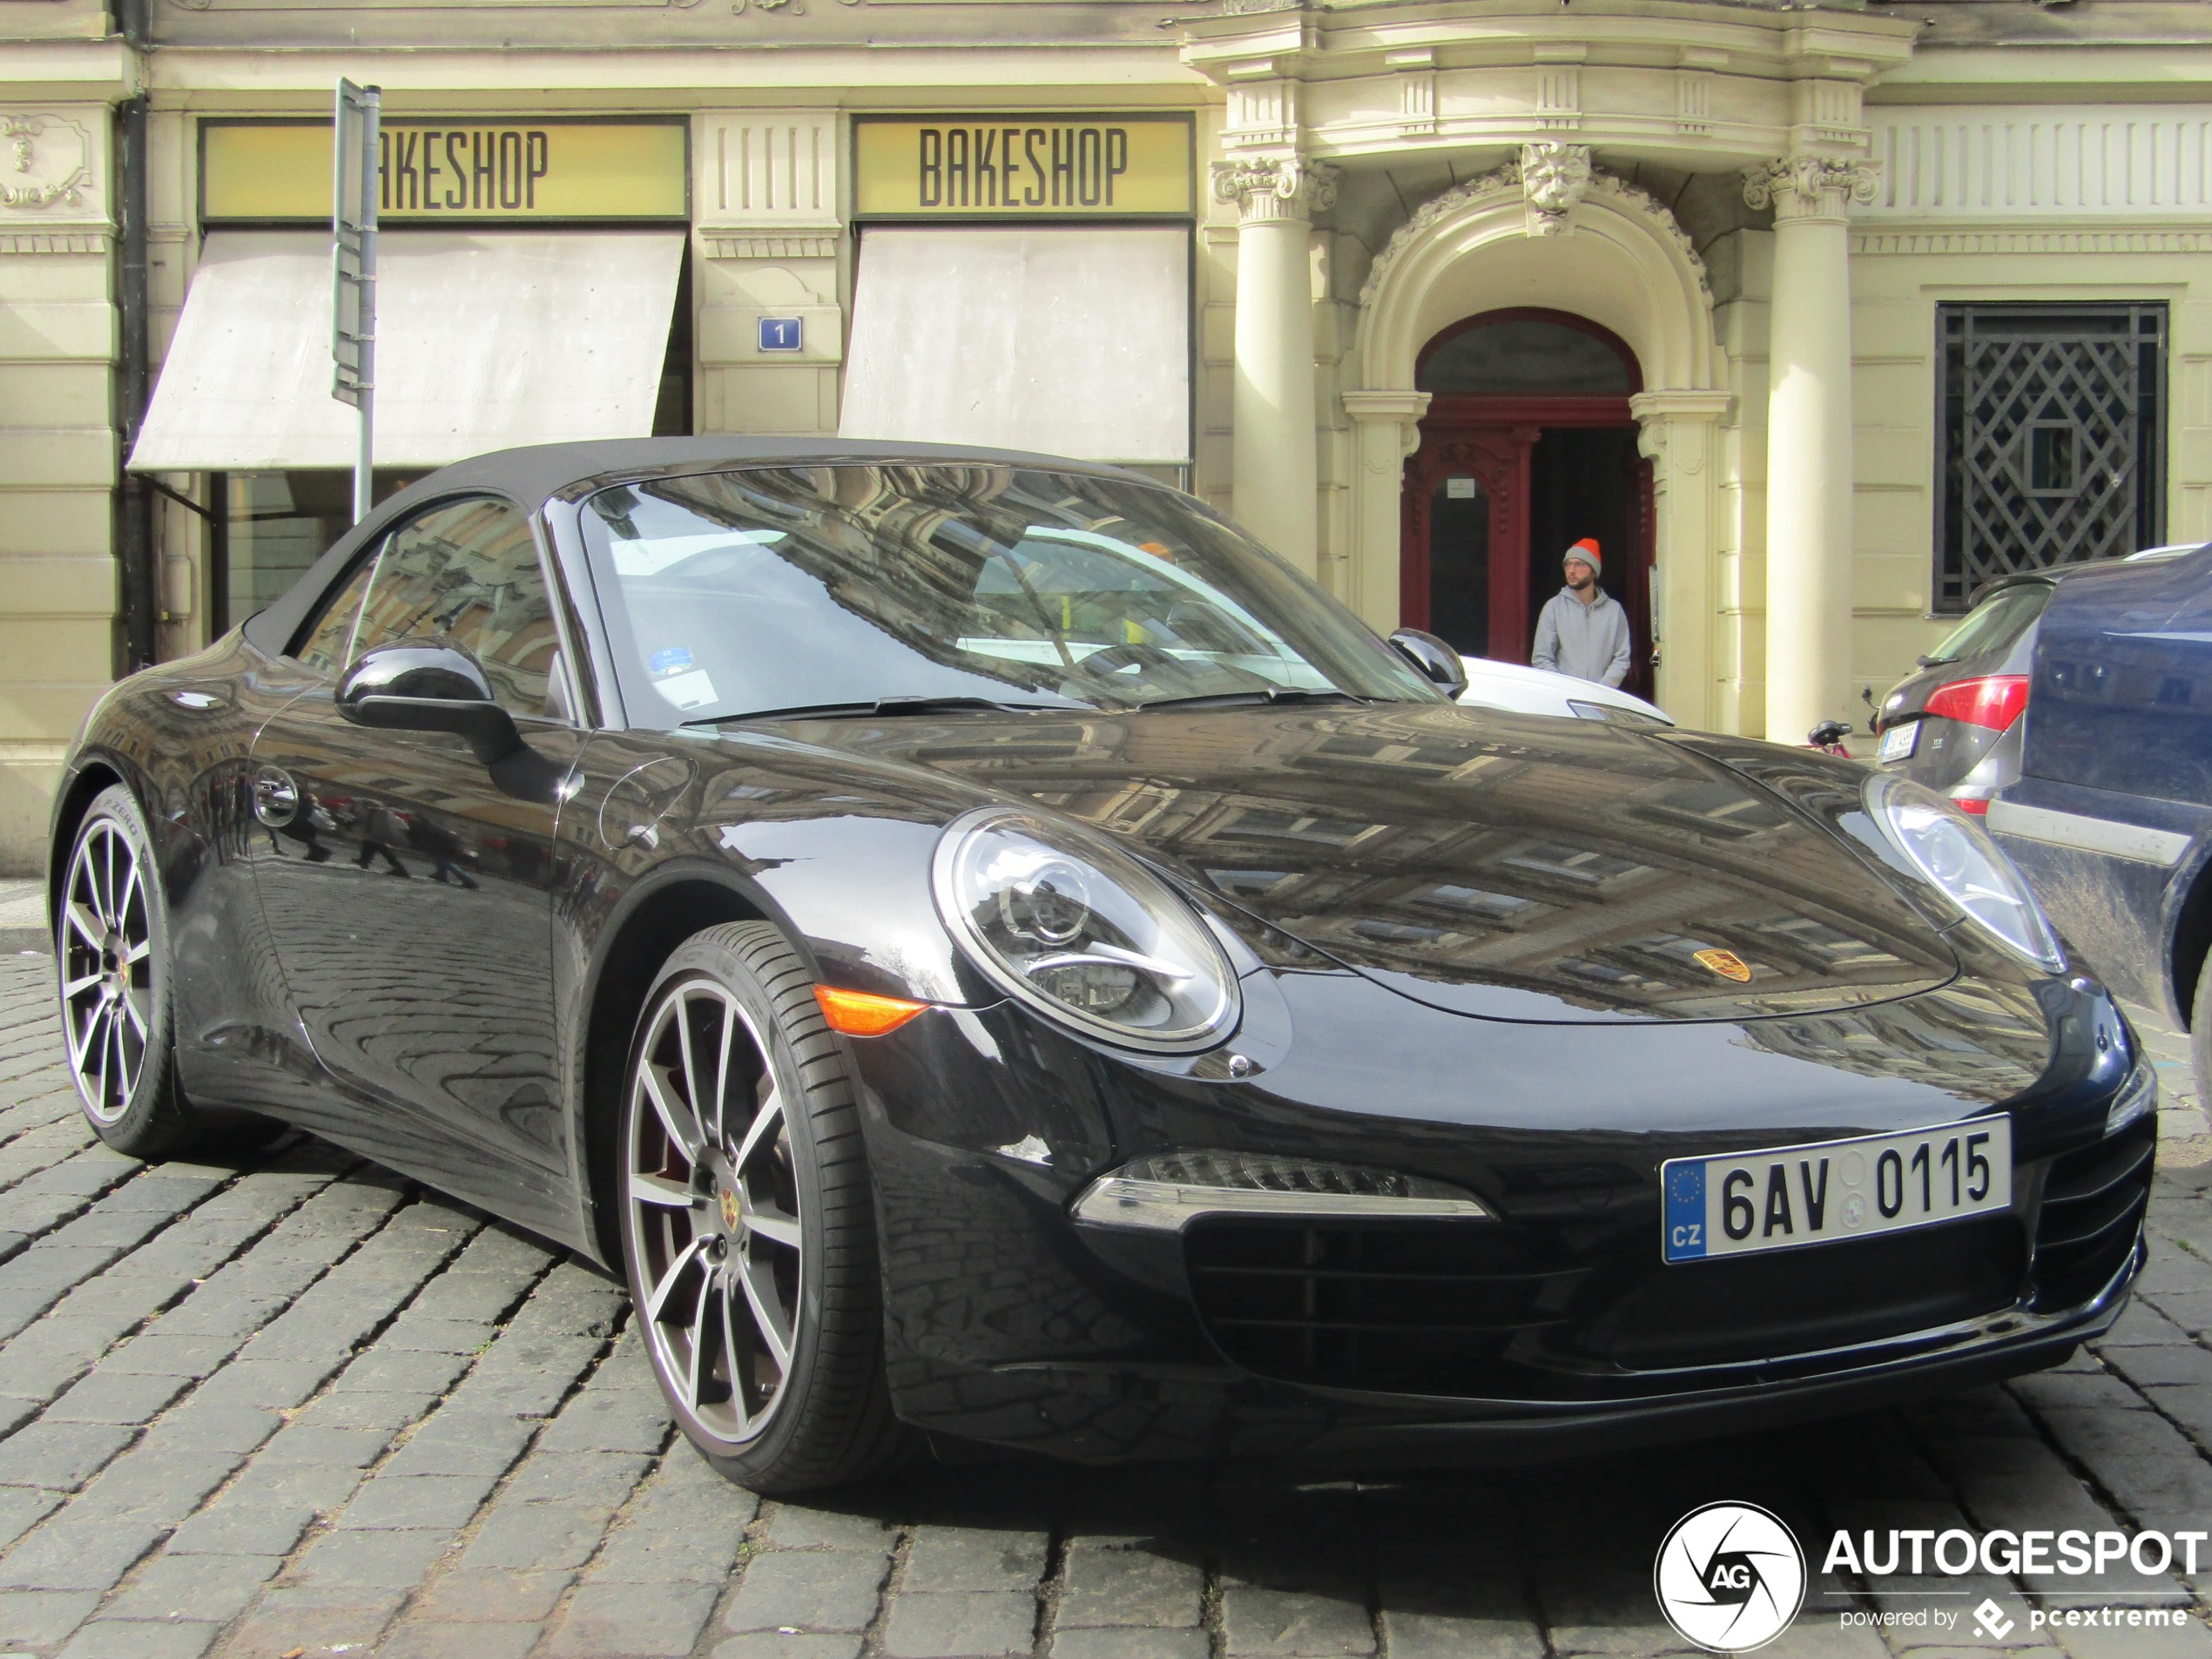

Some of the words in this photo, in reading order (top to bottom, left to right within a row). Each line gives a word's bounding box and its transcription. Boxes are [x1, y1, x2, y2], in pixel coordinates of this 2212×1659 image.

[378, 132, 548, 209] AKESHOP
[920, 128, 1127, 206] BAKESHOP
[775, 324, 784, 343] 1
[1723, 1158, 1829, 1241] 6AV
[1877, 1132, 1990, 1219] 0115
[1672, 1224, 1701, 1247] CZ
